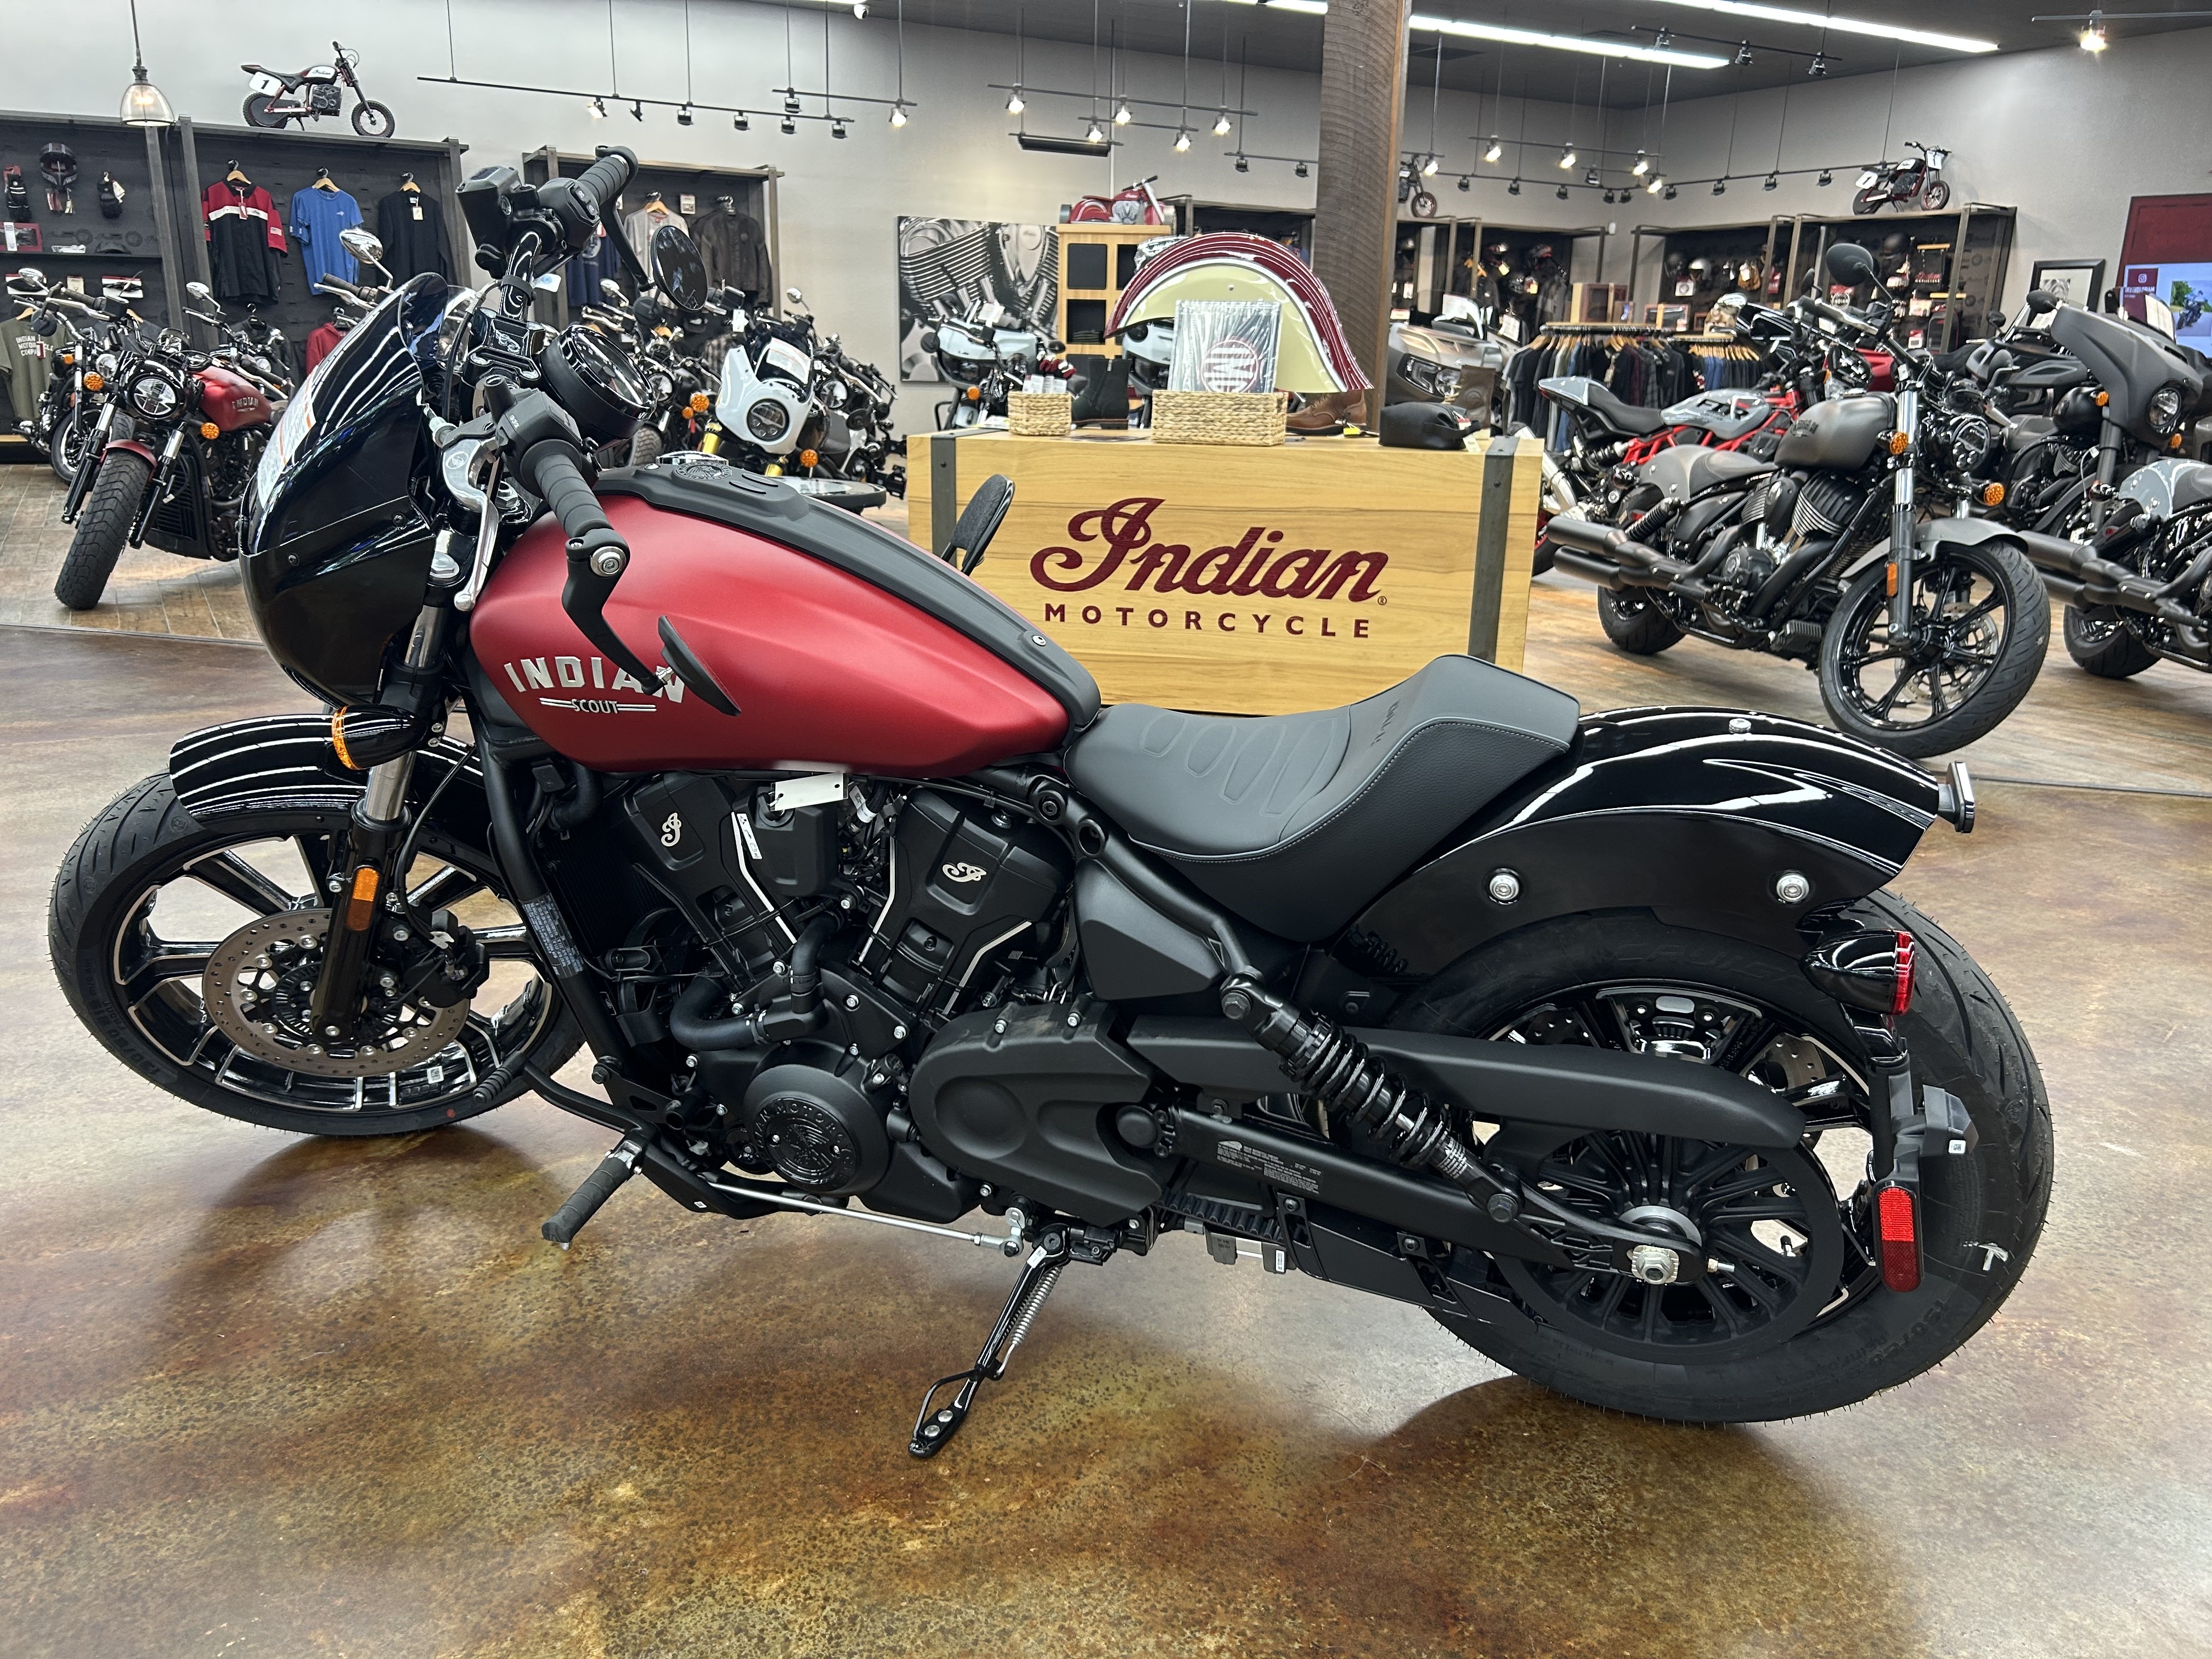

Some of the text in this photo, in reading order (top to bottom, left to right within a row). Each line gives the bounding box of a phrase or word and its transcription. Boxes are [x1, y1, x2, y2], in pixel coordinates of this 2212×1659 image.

[261, 80, 270, 89] 1
[15, 335, 36, 343] INDIAN
[18, 342, 54, 352] MOTORCLE
[20, 348, 37, 357] COMP
[232, 397, 259, 409] INDIAN
[1030, 497, 1389, 602] Indian
[1045, 602, 1370, 639] MOTORCYCLE
[571, 698, 618, 714] SCOUT
